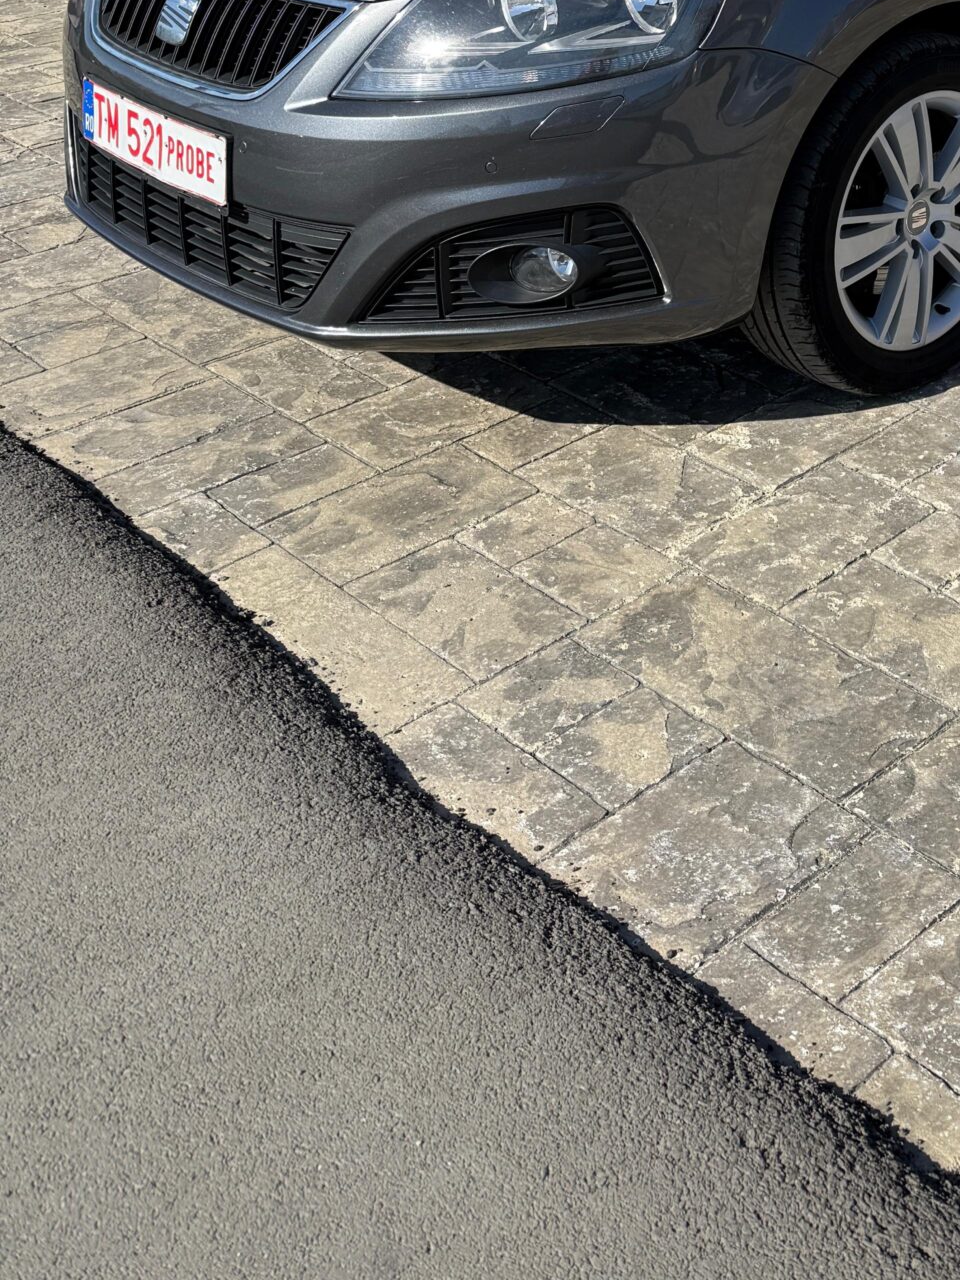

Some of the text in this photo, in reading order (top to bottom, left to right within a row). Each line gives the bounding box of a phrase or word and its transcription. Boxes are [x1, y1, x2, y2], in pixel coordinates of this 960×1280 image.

[85, 112, 94, 132] RO
[94, 91, 215, 184] TM 521 PROBE
